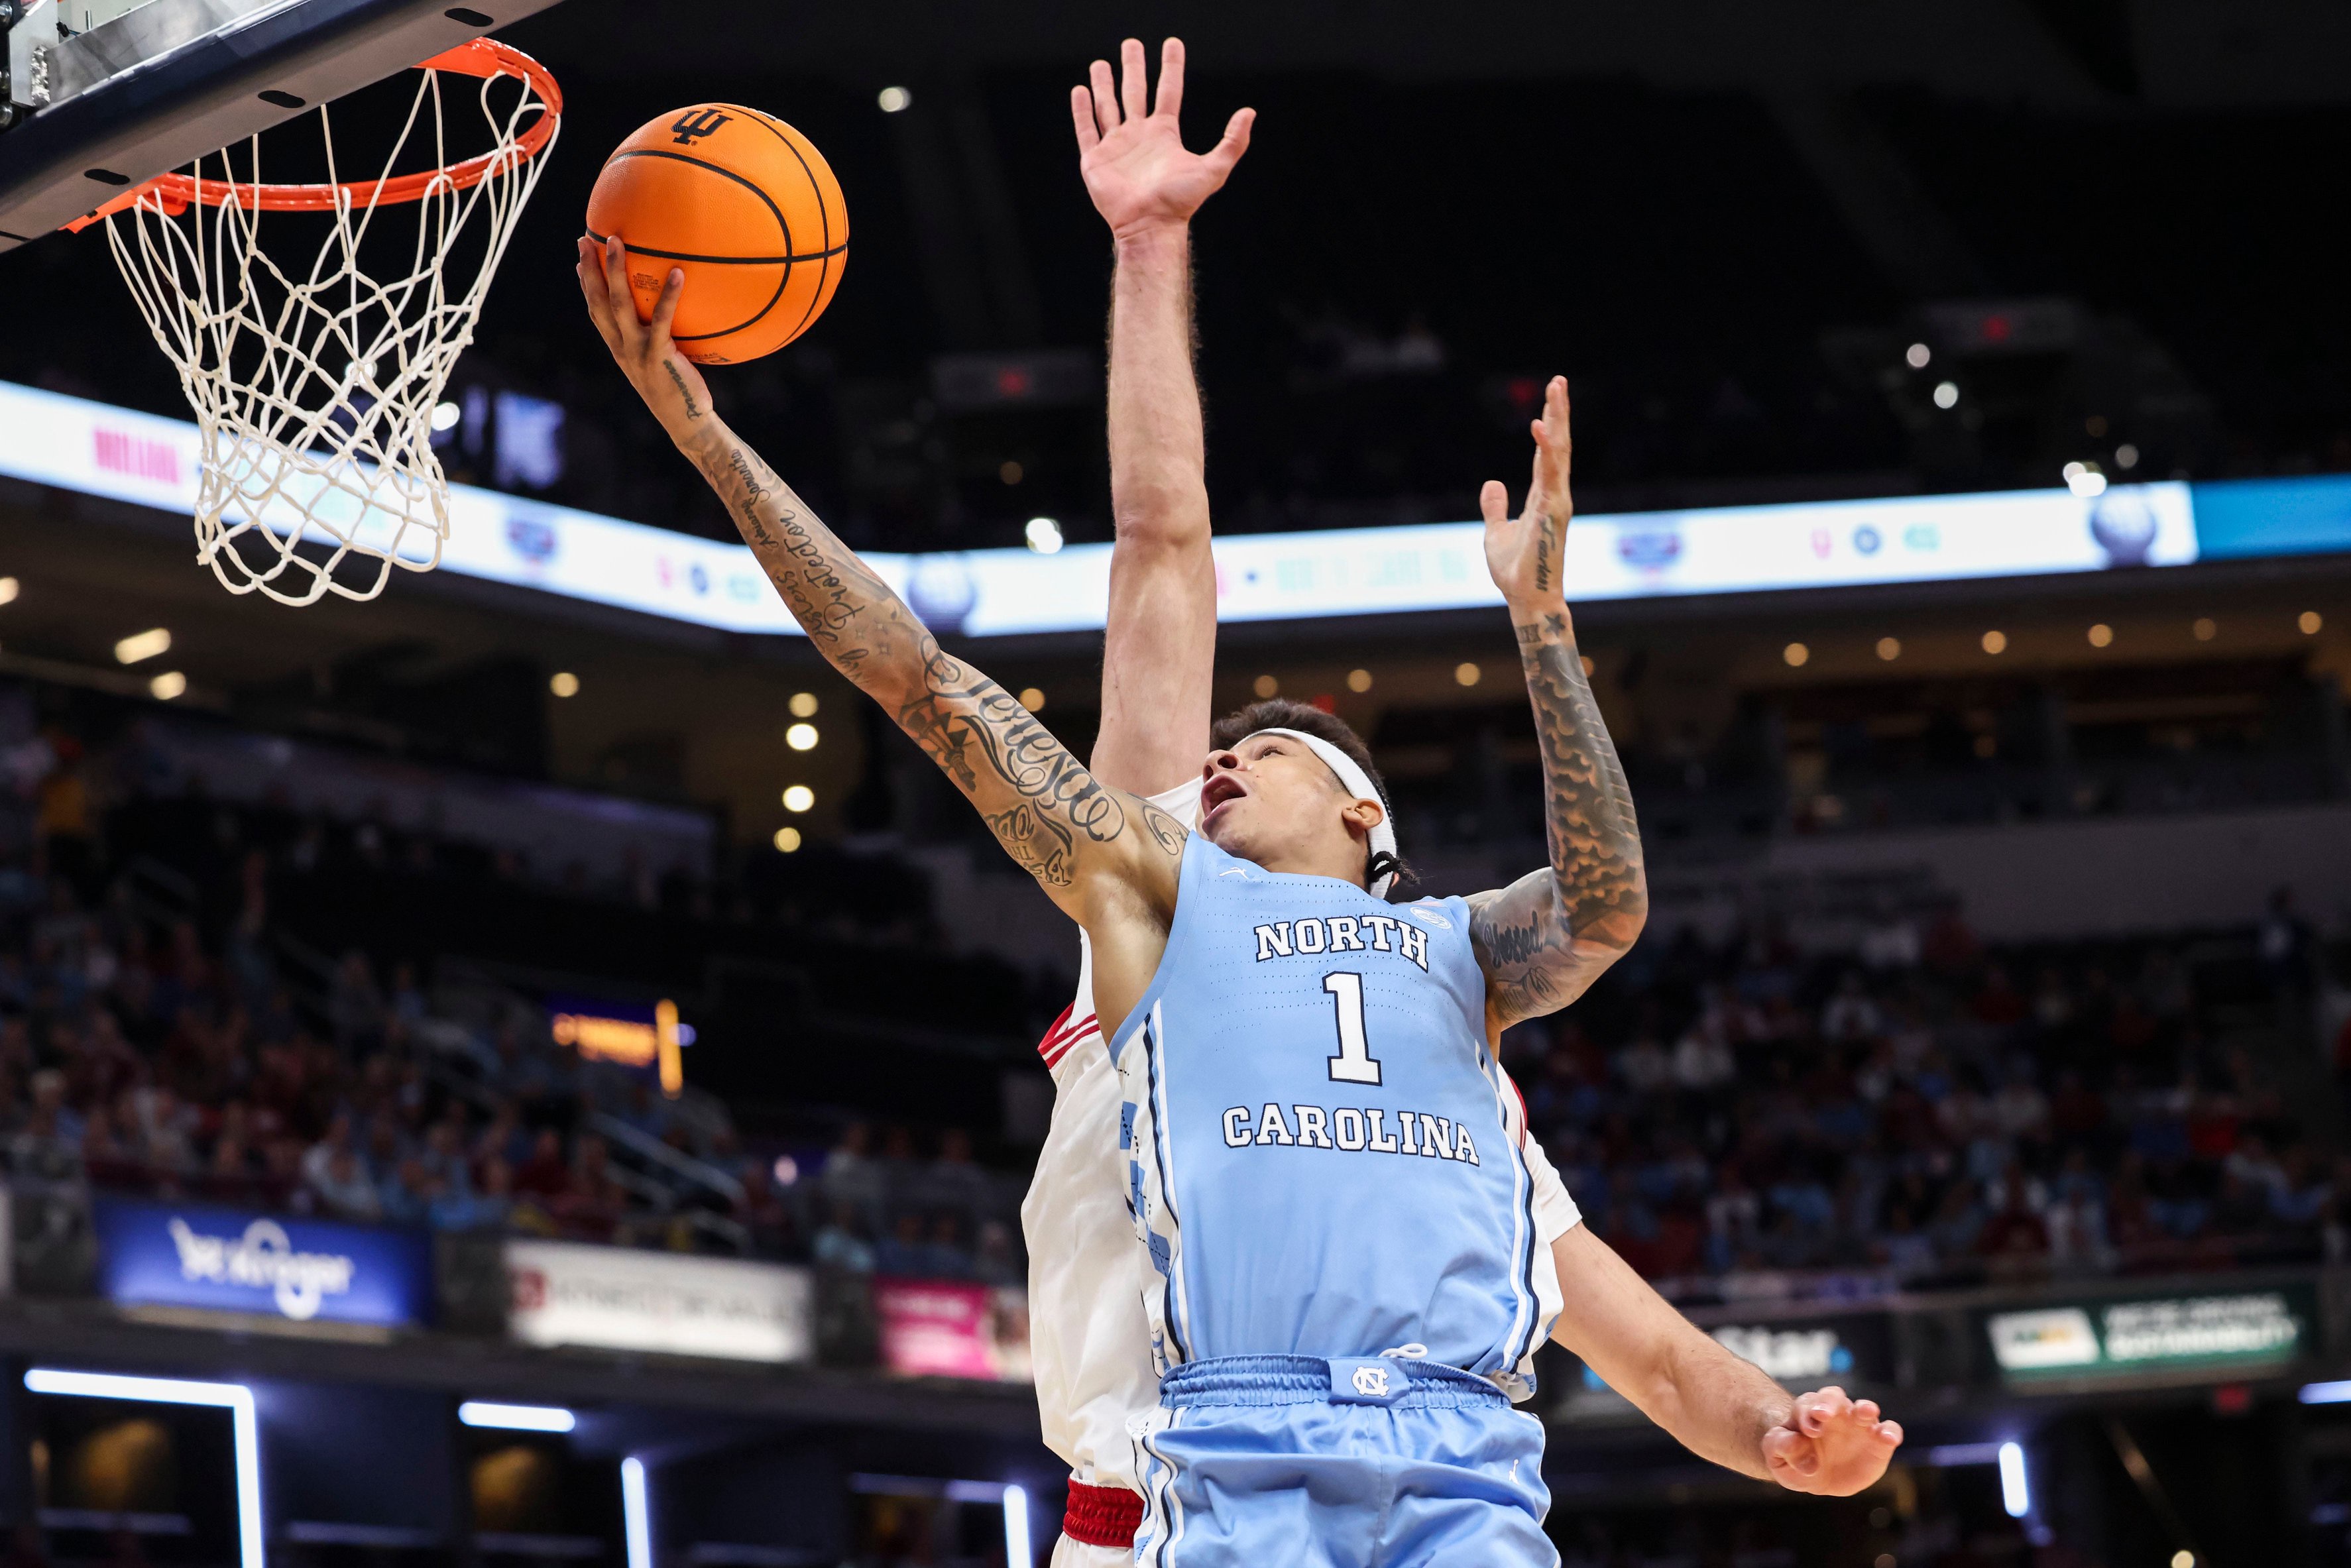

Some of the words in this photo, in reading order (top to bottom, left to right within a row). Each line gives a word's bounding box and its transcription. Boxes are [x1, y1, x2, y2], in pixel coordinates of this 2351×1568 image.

[730, 448, 770, 508] Samantha
[779, 508, 866, 630] Protector
[776, 570, 839, 649] Sisters
[1255, 915, 1428, 973] NORTH
[1323, 971, 1383, 1086] 1
[1222, 1103, 1480, 1167] CAROLINA
